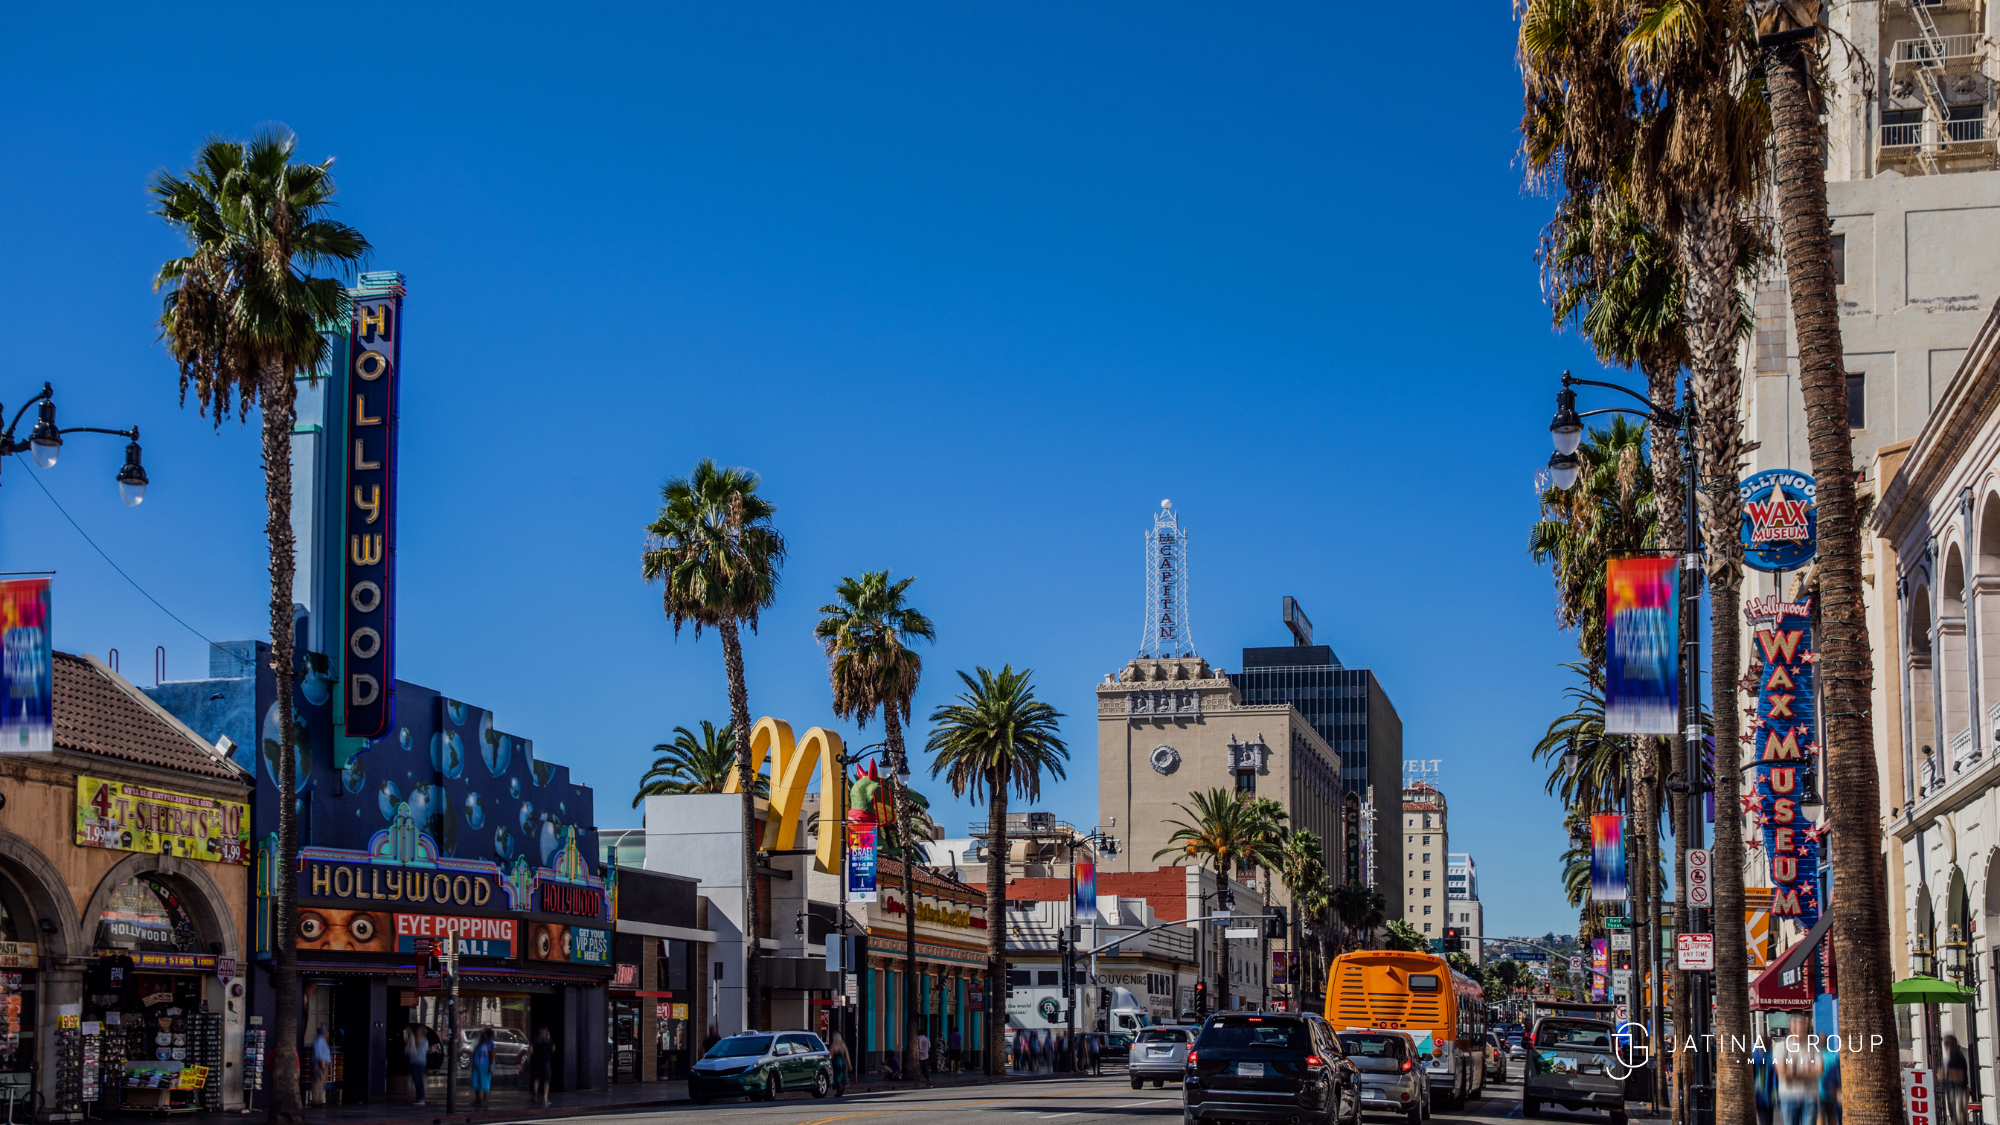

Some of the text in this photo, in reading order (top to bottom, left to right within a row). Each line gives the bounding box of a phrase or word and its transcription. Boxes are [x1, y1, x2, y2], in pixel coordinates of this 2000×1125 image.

[1740, 474, 1816, 504] OLLYWOO
[351, 304, 386, 706] HOLLYWOOD
[1748, 500, 1808, 528] WAX
[1159, 534, 1173, 542] EL
[1752, 526, 1809, 541] MUSEUM
[1160, 546, 1173, 637] CAPITAN
[1747, 596, 1812, 624] Hollywood
[1756, 628, 1803, 719] WAX
[91, 782, 112, 818] 4
[140, 789, 153, 798] BEAT
[191, 797, 199, 805] THE
[116, 798, 208, 840] T-SHIRTS
[1762, 727, 1804, 918] MUSEUM
[1347, 812, 1358, 887] CAPIT
[312, 864, 490, 906] HOLLYWOOD
[543, 884, 601, 918] HOLLYWOOD
[111, 923, 167, 942] HOLLYWOOD
[398, 915, 512, 939] EYE POPPING
[579, 928, 604, 939] GET YOUR
[442, 938, 488, 955] EAL!
[576, 937, 607, 952] VIP PASS
[584, 951, 600, 961] HERE
[142, 954, 166, 965] MOVIE
[169, 956, 194, 966] STARS
[219, 959, 235, 970] ATM
[1098, 974, 1146, 985] OUVENIRS
